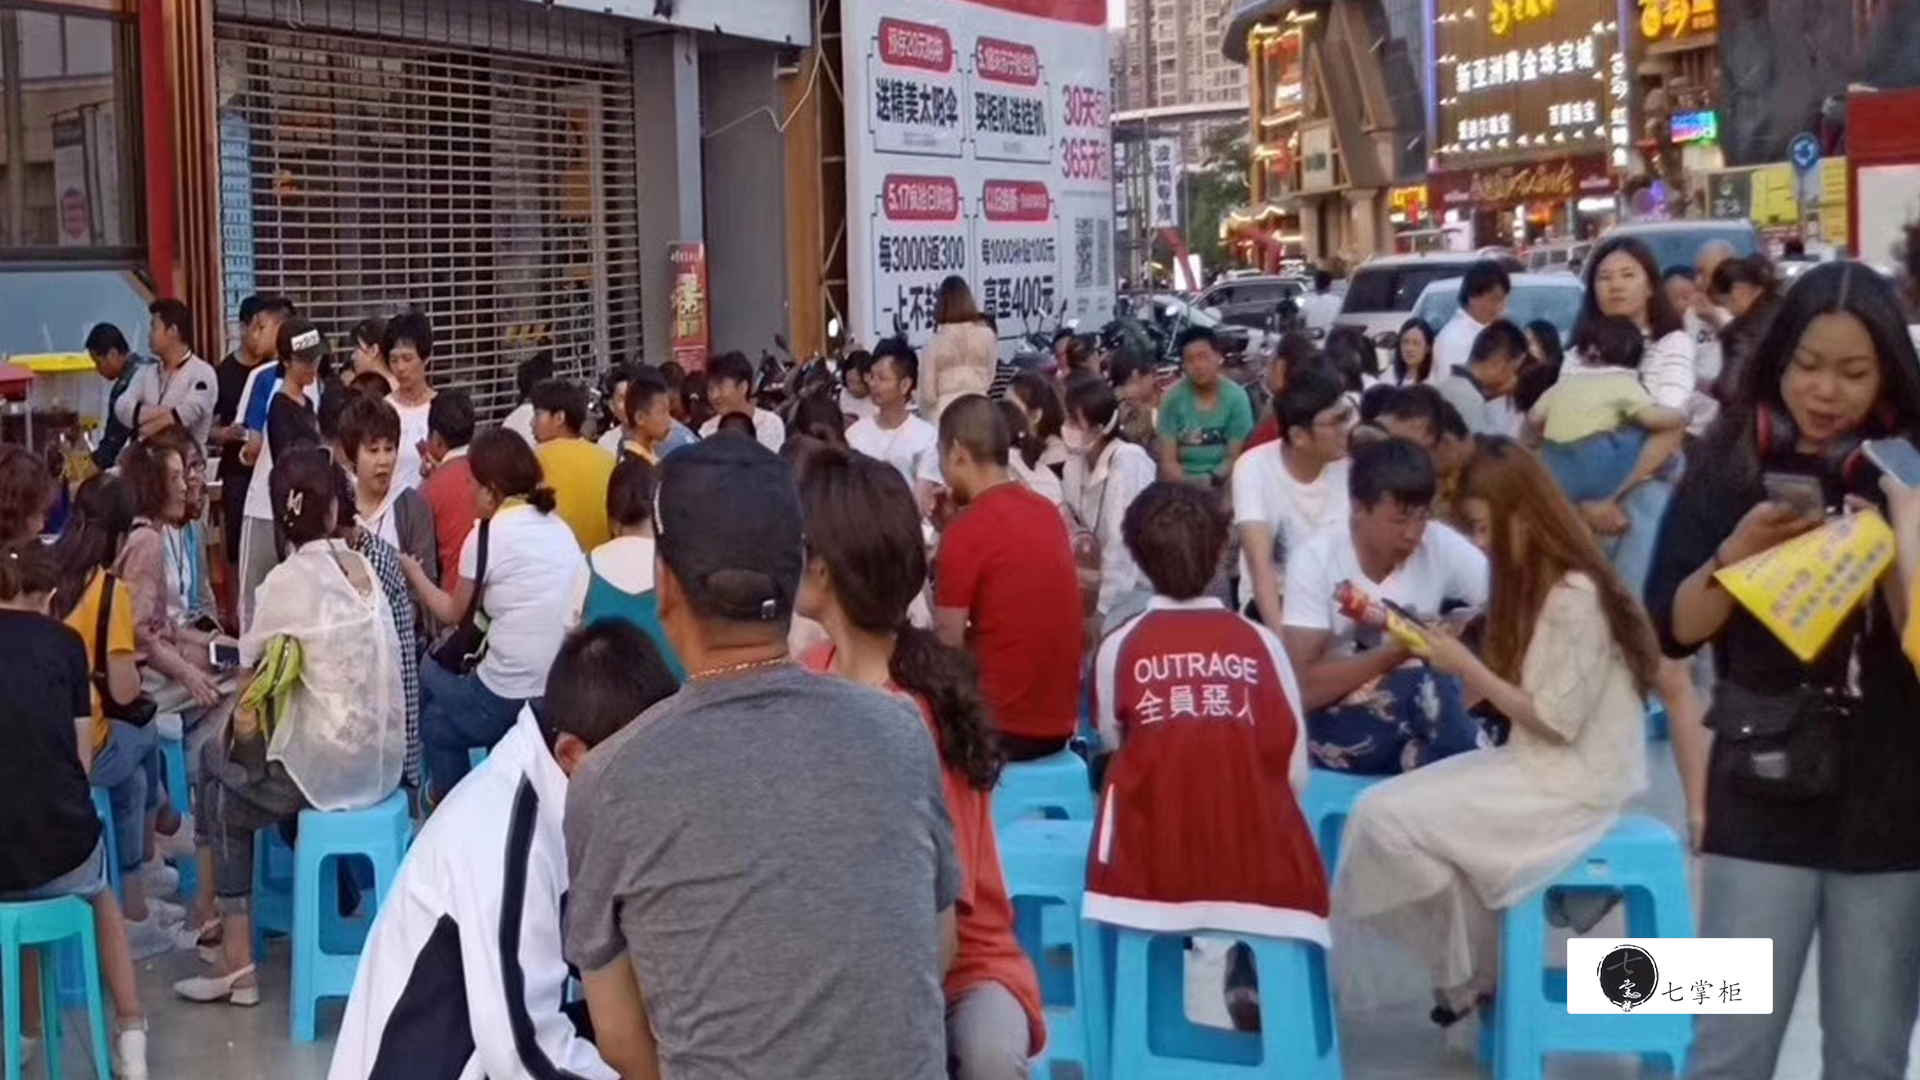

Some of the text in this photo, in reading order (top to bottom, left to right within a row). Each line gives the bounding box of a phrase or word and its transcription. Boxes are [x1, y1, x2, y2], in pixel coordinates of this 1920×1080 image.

[1455, 35, 1595, 93] 新亚洲黄金珠宝城
[875, 77, 959, 129] 送精美太阳伞
[974, 91, 1048, 137] 买柜机送挂机
[879, 234, 966, 273] 每3000返300
[983, 275, 1055, 319] 高至400元
[1134, 651, 1259, 685] OUTRAGE
[1135, 684, 1256, 726] 全員惡人
